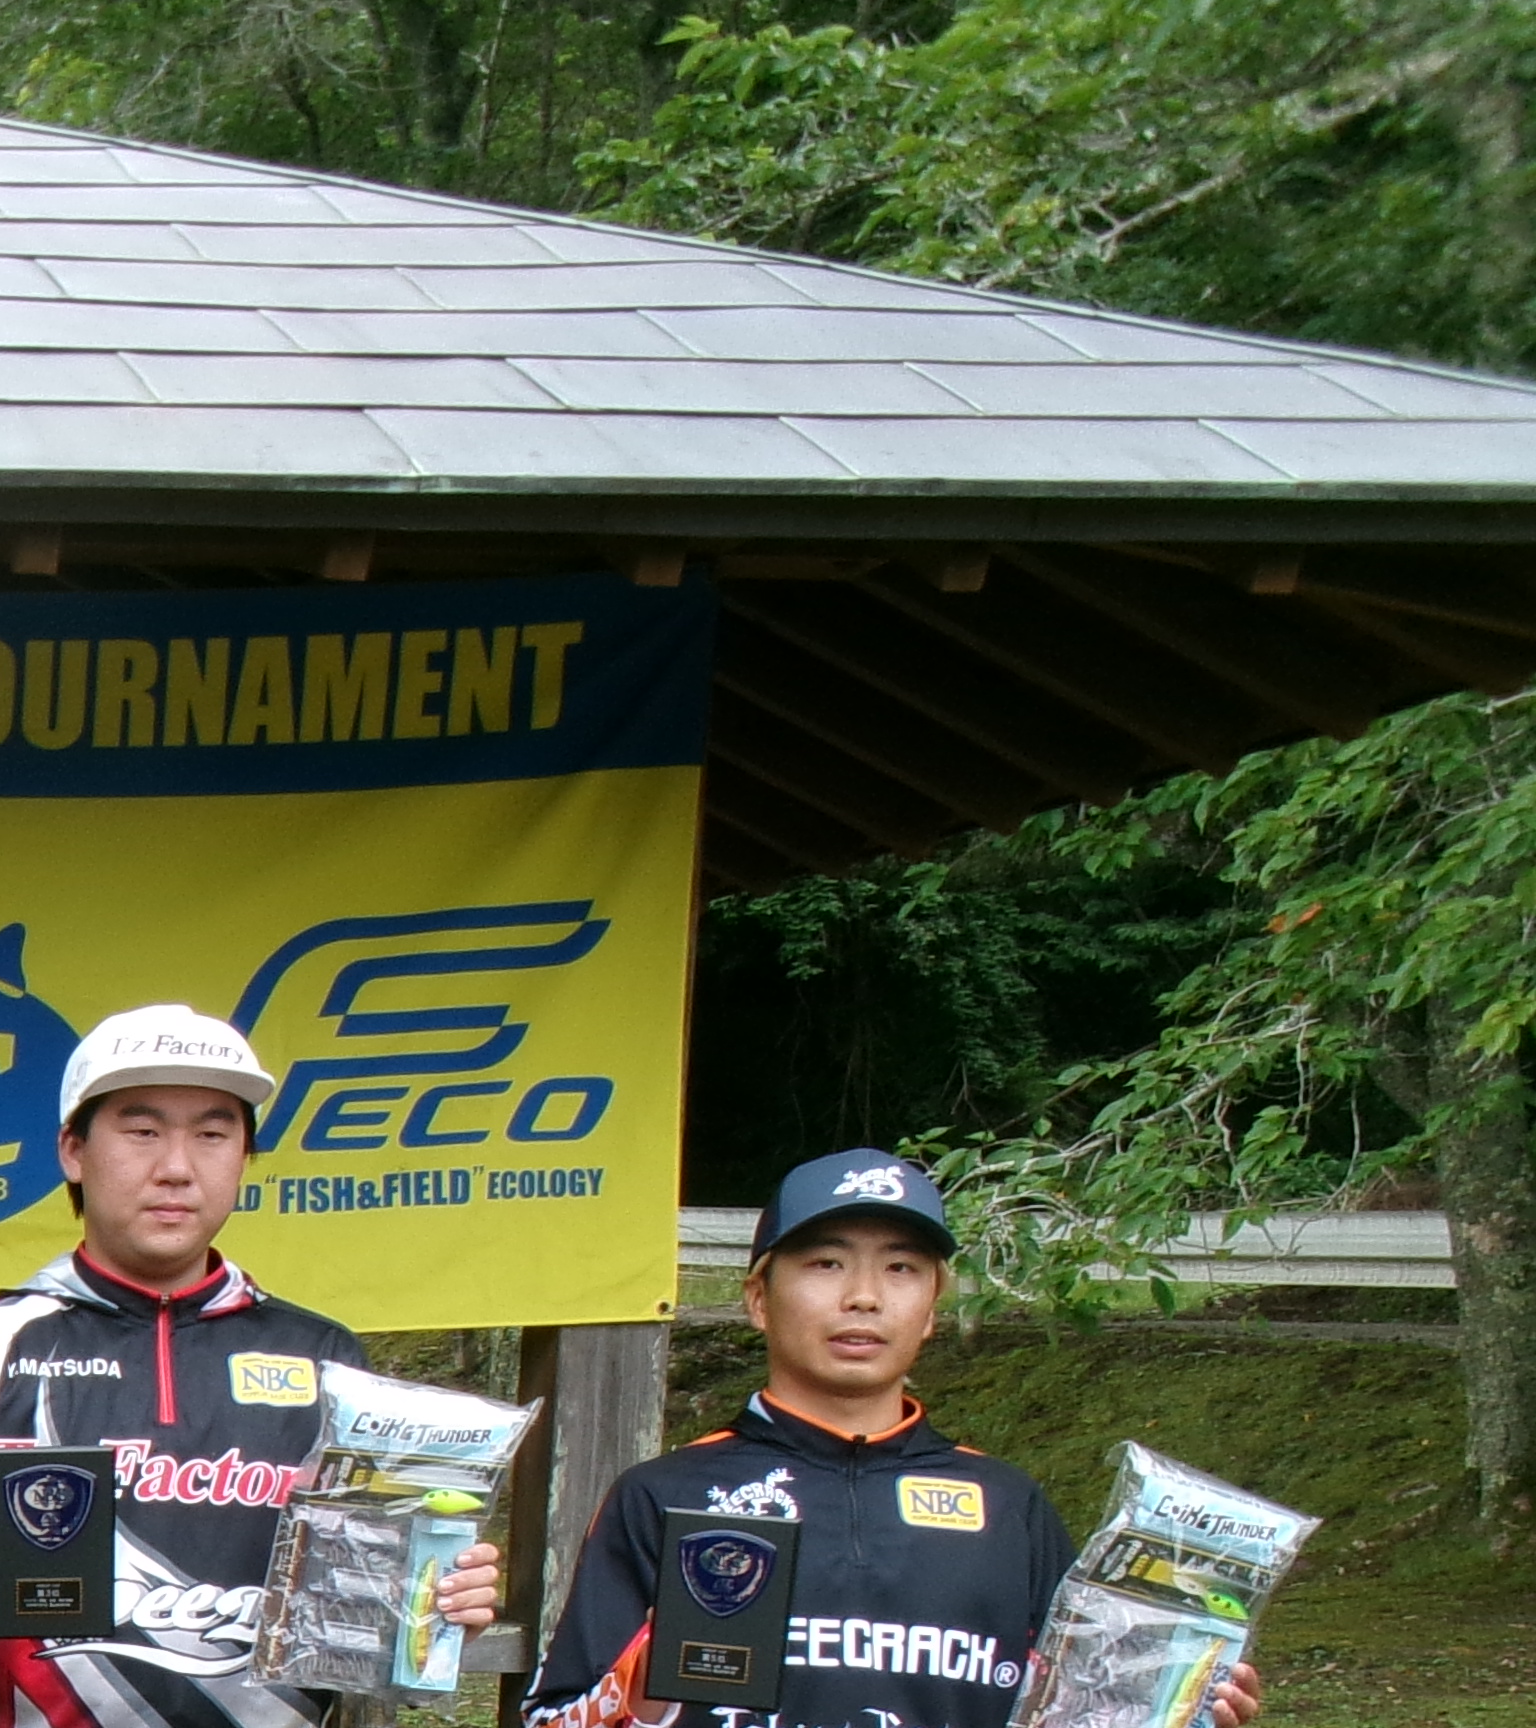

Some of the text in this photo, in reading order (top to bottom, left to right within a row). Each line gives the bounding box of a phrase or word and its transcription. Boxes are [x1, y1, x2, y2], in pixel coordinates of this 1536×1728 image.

[153, 1034, 244, 1064] Factory
[486, 1167, 604, 1200] ECOLOGY
[240, 1365, 308, 1391] NBC
[415, 1424, 492, 1445] THUNDER
[100, 1440, 302, 1508] Factor
[909, 1488, 976, 1517] NBC
[1206, 1514, 1278, 1541] THUNDER
